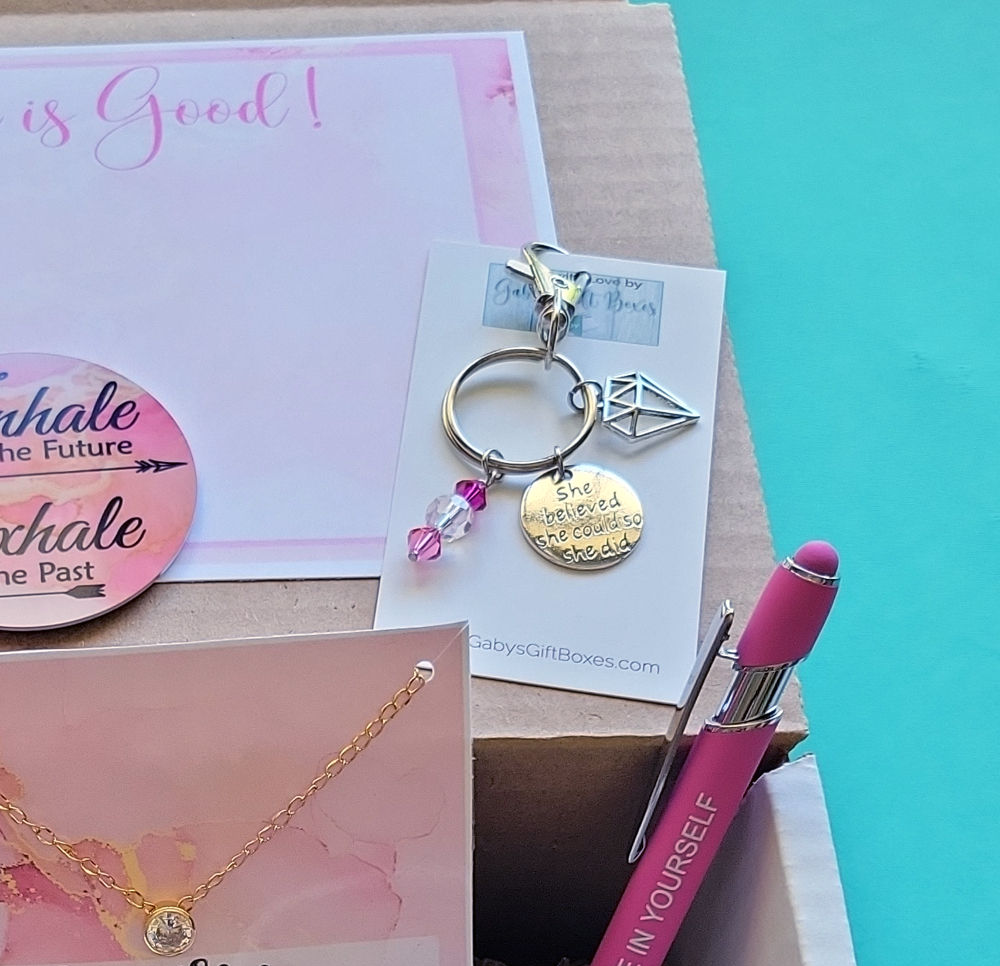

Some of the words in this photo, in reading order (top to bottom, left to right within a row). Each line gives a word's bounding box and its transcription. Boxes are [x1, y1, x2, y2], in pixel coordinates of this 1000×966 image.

[24, 99, 73, 147] is
[625, 278, 643, 291] by
[44, 440, 133, 460] Future
[543, 492, 621, 526] believed
[536, 529, 568, 549] she
[573, 512, 618, 538] could
[623, 513, 642, 528] so
[563, 545, 598, 564] she
[601, 532, 632, 558] did
[39, 562, 95, 583] Past
[469, 634, 660, 675] GabysGiftBoxes.com
[640, 792, 718, 922] YOURSELF
[626, 929, 655, 955] IN
